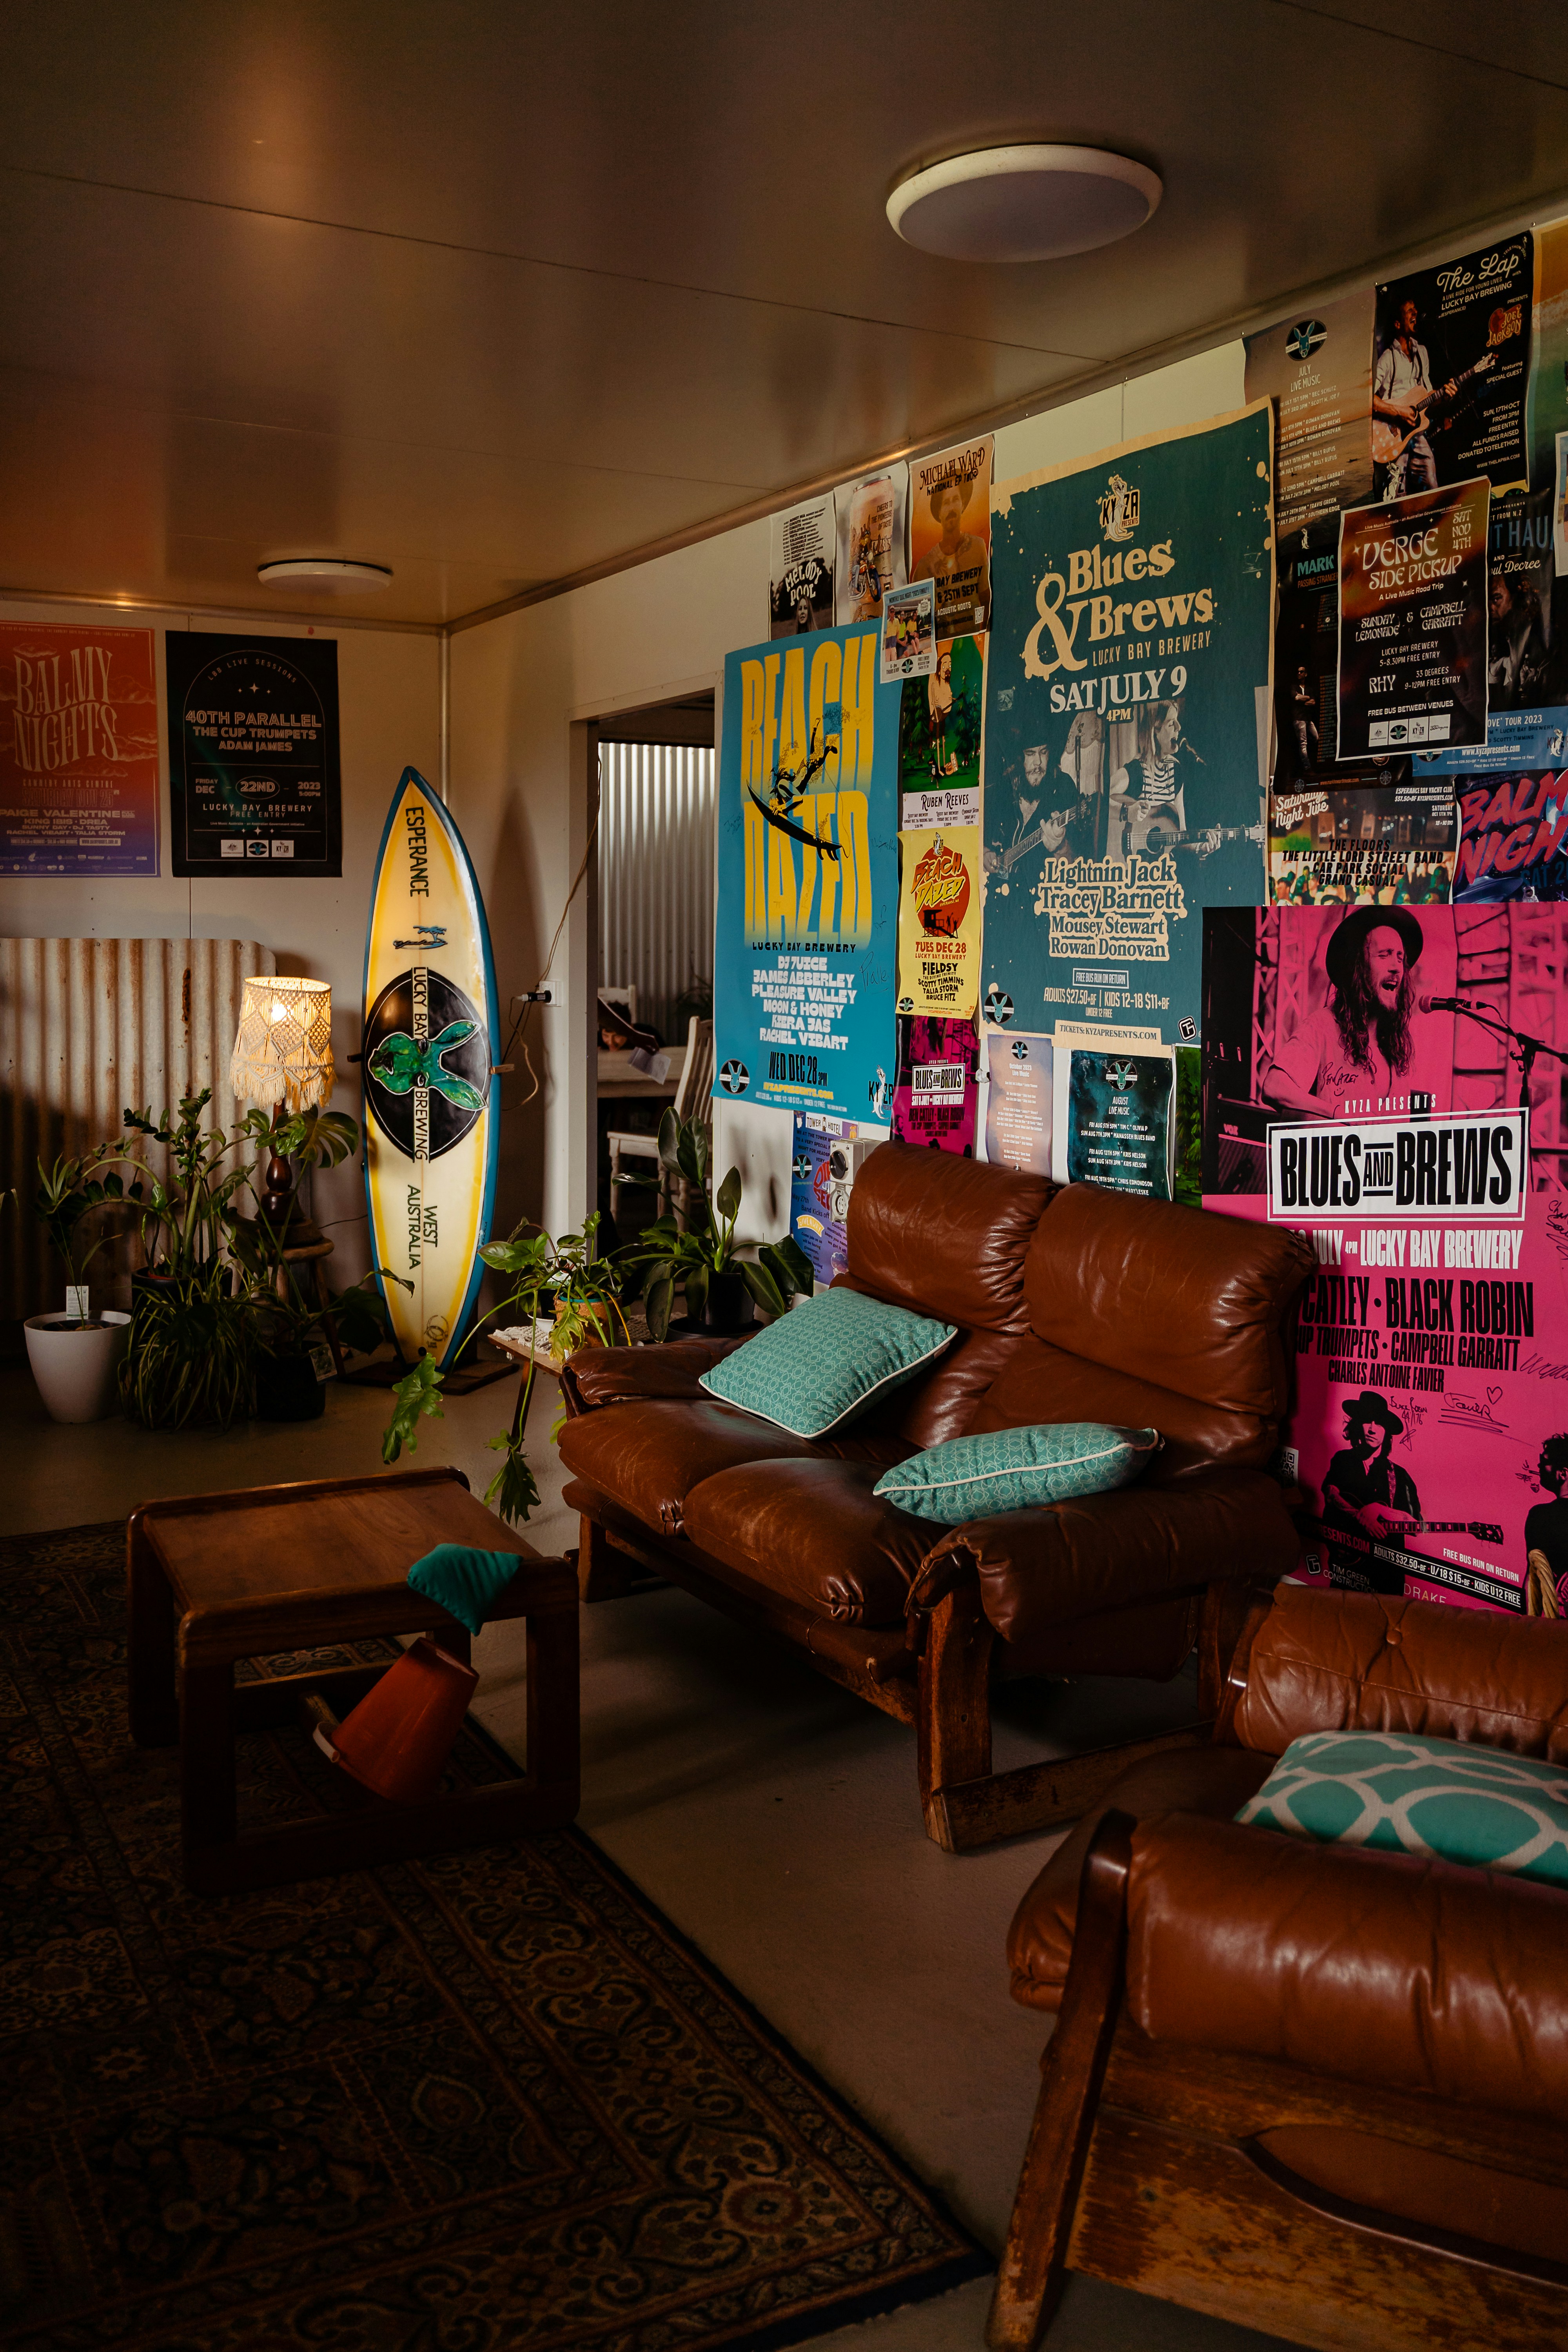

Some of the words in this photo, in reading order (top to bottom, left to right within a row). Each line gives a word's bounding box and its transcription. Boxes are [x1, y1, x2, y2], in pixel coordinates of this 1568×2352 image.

[1437, 267, 1474, 292] The
[1479, 253, 1519, 278] Lap
[1442, 297, 1464, 310] LUCKY
[1465, 292, 1479, 303] BAY
[1480, 281, 1512, 297] BREWING
[1299, 365, 1311, 377] JULY
[1291, 379, 1301, 392] LIVE
[1303, 374, 1321, 388] MUSIC
[920, 459, 960, 490] MICHAEL
[958, 447, 985, 477] WARD
[1453, 510, 1472, 523] SAT
[1452, 523, 1470, 537] NOV
[1363, 528, 1438, 570] VERGE
[1453, 537, 1471, 550] 4TH
[1067, 539, 1175, 597] Blues
[1298, 555, 1334, 576] MARK
[1369, 567, 1405, 590] SIDE
[1408, 555, 1462, 583] PICKUP
[1399, 588, 1414, 597] Music
[1416, 585, 1430, 593] Road
[1088, 588, 1215, 642] Brews
[1407, 612, 1413, 622] &
[1420, 601, 1466, 618] CAMPBELL
[1022, 572, 1088, 680] &
[1361, 613, 1395, 628] SUNDAY
[1422, 614, 1463, 630] GARRATT
[1356, 625, 1399, 642] LEMONADE
[1093, 646, 1120, 666] LUCKY
[1128, 641, 1151, 660] BAY
[1159, 630, 1211, 656] BREWERY
[14, 646, 113, 715] BALMY
[1050, 677, 1098, 713] SAT
[1097, 668, 1166, 715] JULY
[1171, 665, 1187, 697] 9
[1370, 675, 1396, 693] RHY
[1106, 708, 1131, 722] 4PM
[1398, 703, 1426, 713] BETWEEN
[1428, 700, 1453, 708] VENUES
[185, 710, 230, 724] 40TH
[235, 712, 322, 728] PARALLEL
[740, 633, 877, 804] BEACH
[1505, 717, 1521, 726] TOUR
[1524, 715, 1542, 724] 2023
[13, 703, 118, 772] NIGHTS
[192, 726, 218, 737] THE
[221, 727, 246, 738] CUP
[249, 728, 317, 740] TRUMPETS
[219, 741, 253, 751] ADAM
[255, 741, 292, 752] JAMES
[1462, 745, 1520, 757] www.kyzapresents.com
[240, 781, 275, 793] 22ND
[1276, 805, 1303, 829] Night
[1306, 801, 1328, 817] Jive
[405, 807, 429, 897] ESPERANCE
[1329, 839, 1347, 850] THE
[1350, 840, 1391, 851] FLOORS
[1453, 816, 1568, 885] NIGH
[1283, 850, 1300, 862] THE
[1302, 851, 1338, 862] LITTLE
[1339, 851, 1364, 863] LORD
[1368, 851, 1411, 863] STREET
[1414, 851, 1443, 864] BAND
[744, 790, 873, 951] DAZED
[910, 852, 962, 894] BEACH
[1046, 859, 1124, 887] Lightnin
[1126, 856, 1174, 889] Jack
[1313, 862, 1332, 873] CAR
[1336, 863, 1361, 874] PARK
[1365, 863, 1405, 875] SOCIAL
[1319, 874, 1352, 886] GRAND
[1355, 875, 1396, 887] CASUAL
[915, 878, 965, 913] DAZED
[1040, 886, 1099, 916] Tracey
[1102, 886, 1181, 910] Barnett
[1052, 916, 1102, 937] Mousey
[1105, 917, 1164, 935] Stewart
[752, 942, 784, 951] LUCKY
[787, 942, 800, 951] BAY
[805, 943, 856, 953] BREWERY
[916, 942, 934, 953] TUES
[936, 942, 953, 953] DEC
[955, 942, 967, 954] 28
[1051, 938, 1096, 955] Rowan
[1099, 938, 1167, 958] Donovan
[922, 962, 958, 975] FIELDSY
[1076, 972, 1085, 982] FREE
[1085, 973, 1094, 983] BUS
[1102, 974, 1108, 984] ON
[1109, 974, 1125, 984] RETURN
[413, 967, 427, 1007] LUCKY
[918, 978, 936, 987] SCOTTY
[938, 976, 964, 986] TIMMINS
[940, 984, 958, 993] STORM
[752, 984, 805, 1001] PLEASURE
[808, 988, 857, 1004] VALLEY
[944, 993, 956, 1001] FITZ
[1044, 987, 1065, 1002] ADULTS
[1066, 989, 1096, 1005] $27.50+BF
[1105, 991, 1120, 1007] KIDS
[1122, 993, 1143, 1008] 12-18
[1145, 992, 1169, 1009] $11+BF
[763, 1000, 789, 1014] MOON
[790, 1002, 797, 1014] &
[800, 1003, 844, 1018] HONEY
[414, 1014, 427, 1039] BAY
[1060, 1025, 1085, 1034] TICKETS:
[1085, 1027, 1157, 1040] KYZAPRESENTS.COM
[1109, 1106, 1117, 1114] LIVE
[1118, 1107, 1129, 1115] MUSIC
[1112, 1096, 1128, 1105] AUGUST
[1345, 1100, 1371, 1114] KYZA
[1379, 1094, 1437, 1112] PRESENTS
[415, 1091, 428, 1161] BREWING
[807, 1117, 821, 1128] TOWER
[828, 1122, 841, 1135] HOTEL
[1280, 1134, 1361, 1207] BLUES
[1363, 1151, 1394, 1187] AND
[1396, 1125, 1513, 1206] BREWS
[407, 1185, 421, 1270] AUSTRALIA
[424, 1205, 437, 1248] WEST
[1312, 1230, 1343, 1265] JULY
[1345, 1241, 1357, 1254] 4PM
[1360, 1230, 1406, 1267] LUCKY
[1410, 1230, 1441, 1268] BAY
[1445, 1230, 1523, 1269] BREWERY
[1302, 1276, 1370, 1327] CATLEY
[1385, 1277, 1454, 1332] BLACK
[1460, 1280, 1534, 1338] ROBIN
[1317, 1326, 1379, 1359] TRUMPETS
[1391, 1331, 1454, 1366] CAMPBELL
[1458, 1335, 1520, 1371] GARRATT
[1328, 1360, 1367, 1385] CHARLES
[1369, 1363, 1410, 1389] ANTOINE
[1412, 1366, 1444, 1393] FAVIER
[1443, 1548, 1458, 1561] FREE
[1459, 1552, 1472, 1564] BUS
[1473, 1557, 1485, 1568] RUN
[1486, 1561, 1494, 1572] ON
[1495, 1565, 1519, 1582] RETURN
